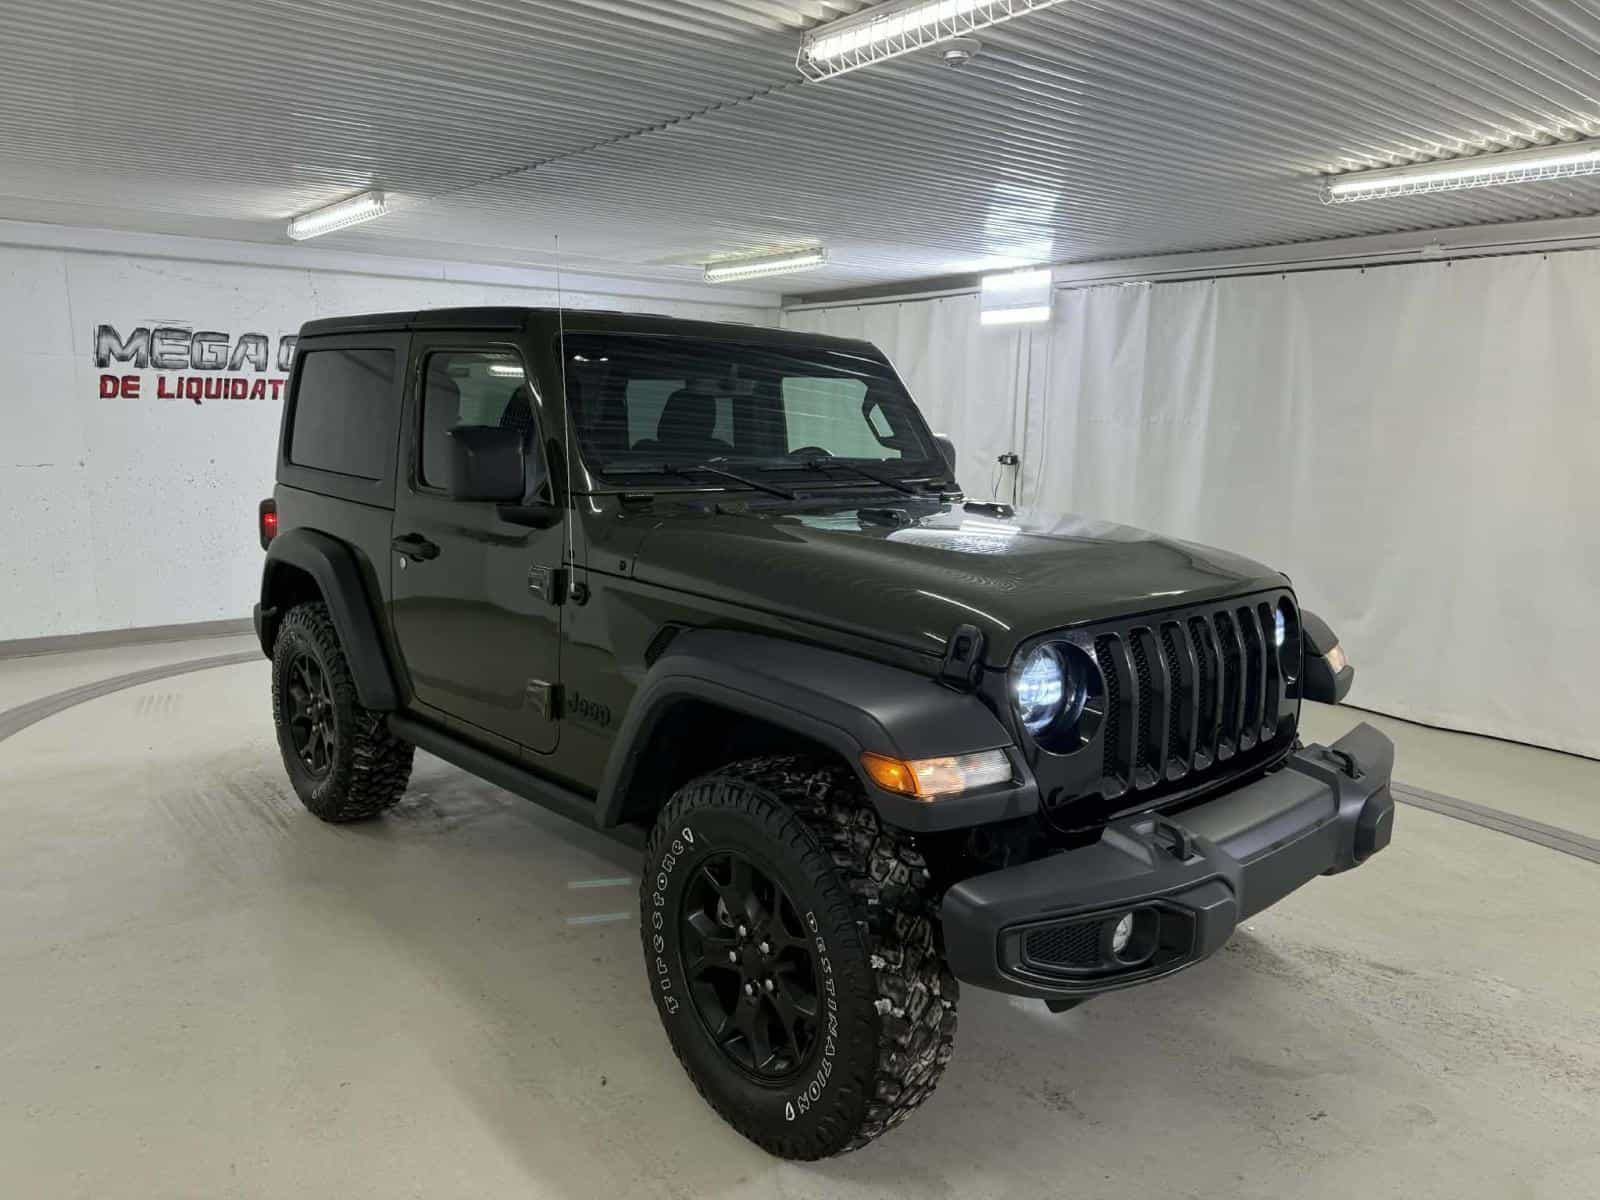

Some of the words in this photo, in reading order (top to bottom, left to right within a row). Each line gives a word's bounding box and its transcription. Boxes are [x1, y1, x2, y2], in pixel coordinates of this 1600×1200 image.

[94, 325, 269, 371] MEGA
[100, 374, 141, 400] DE
[567, 690, 612, 727] Jeep
